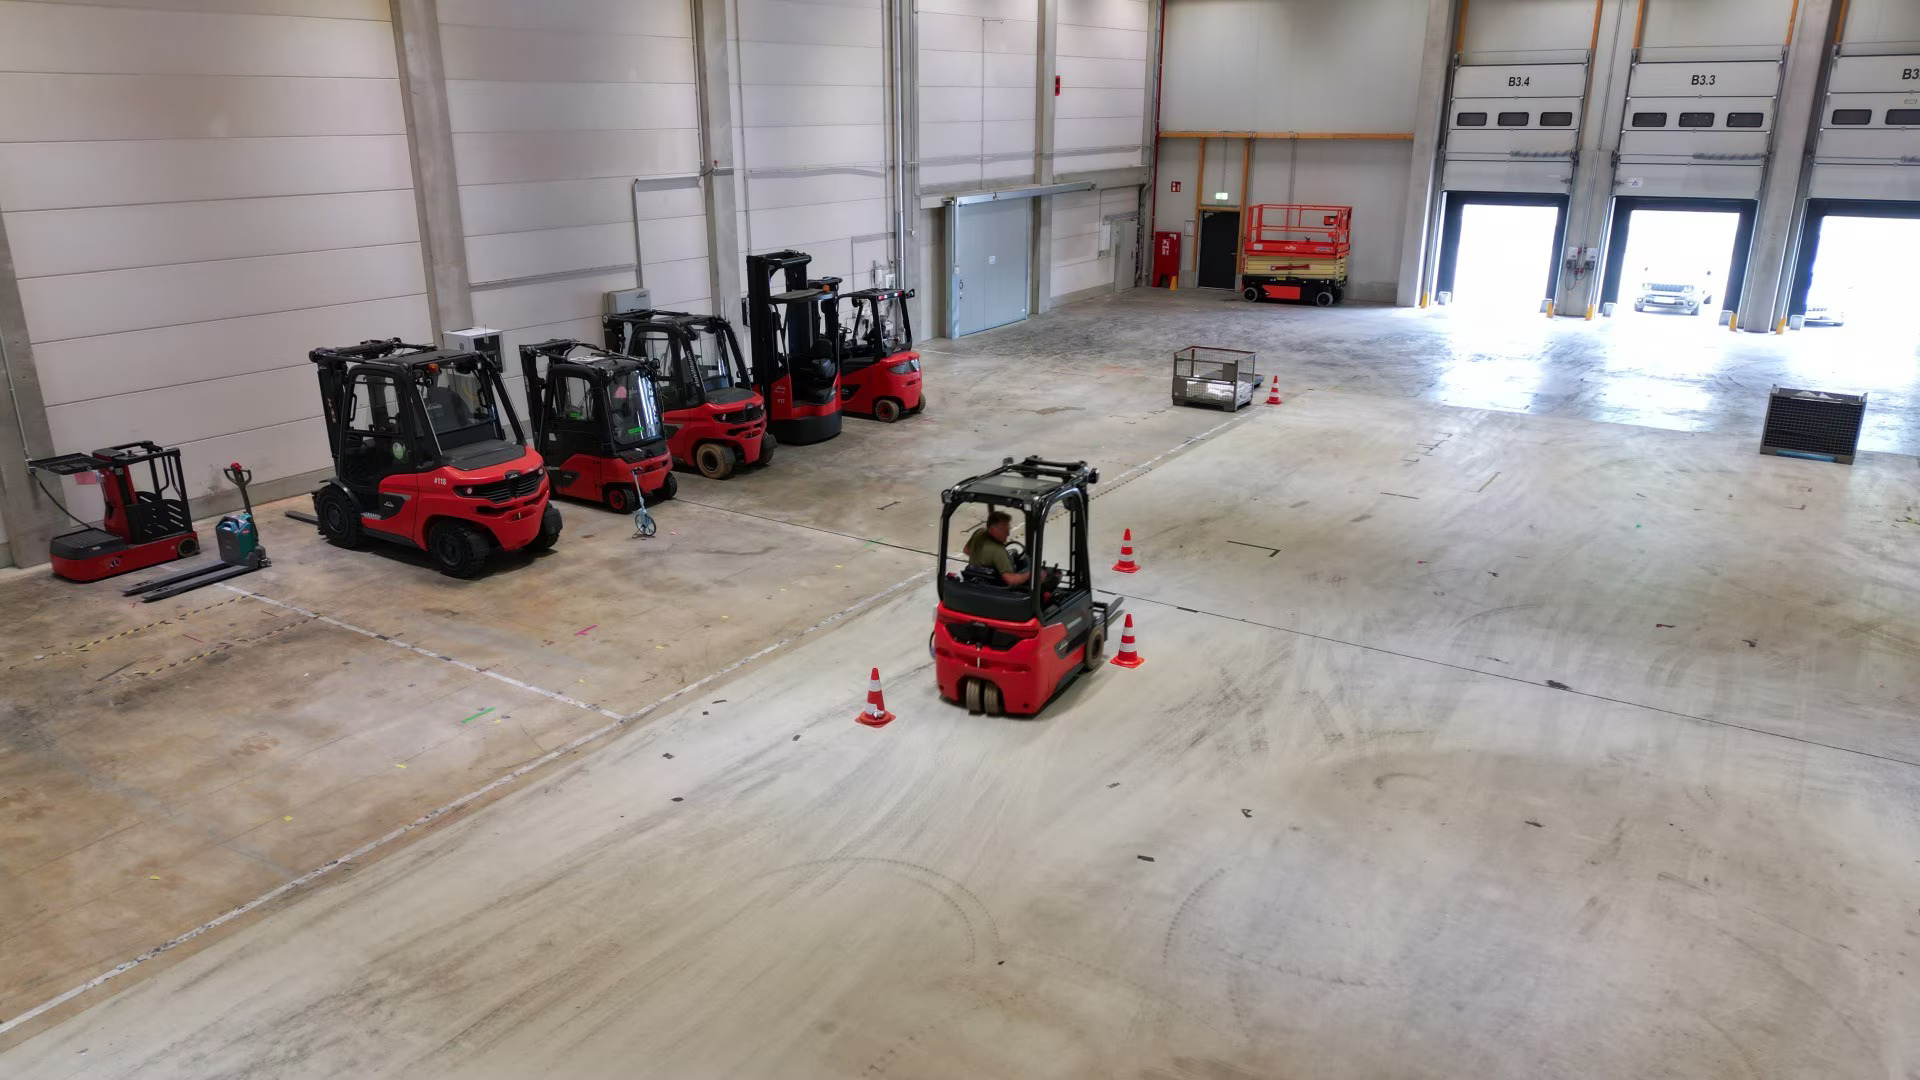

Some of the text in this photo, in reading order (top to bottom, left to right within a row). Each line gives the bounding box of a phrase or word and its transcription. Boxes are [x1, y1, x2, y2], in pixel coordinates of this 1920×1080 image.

[1508, 77, 1530, 87] B3.4
[1691, 75, 1715, 86] B3.3
[434, 477, 447, 485] #118
